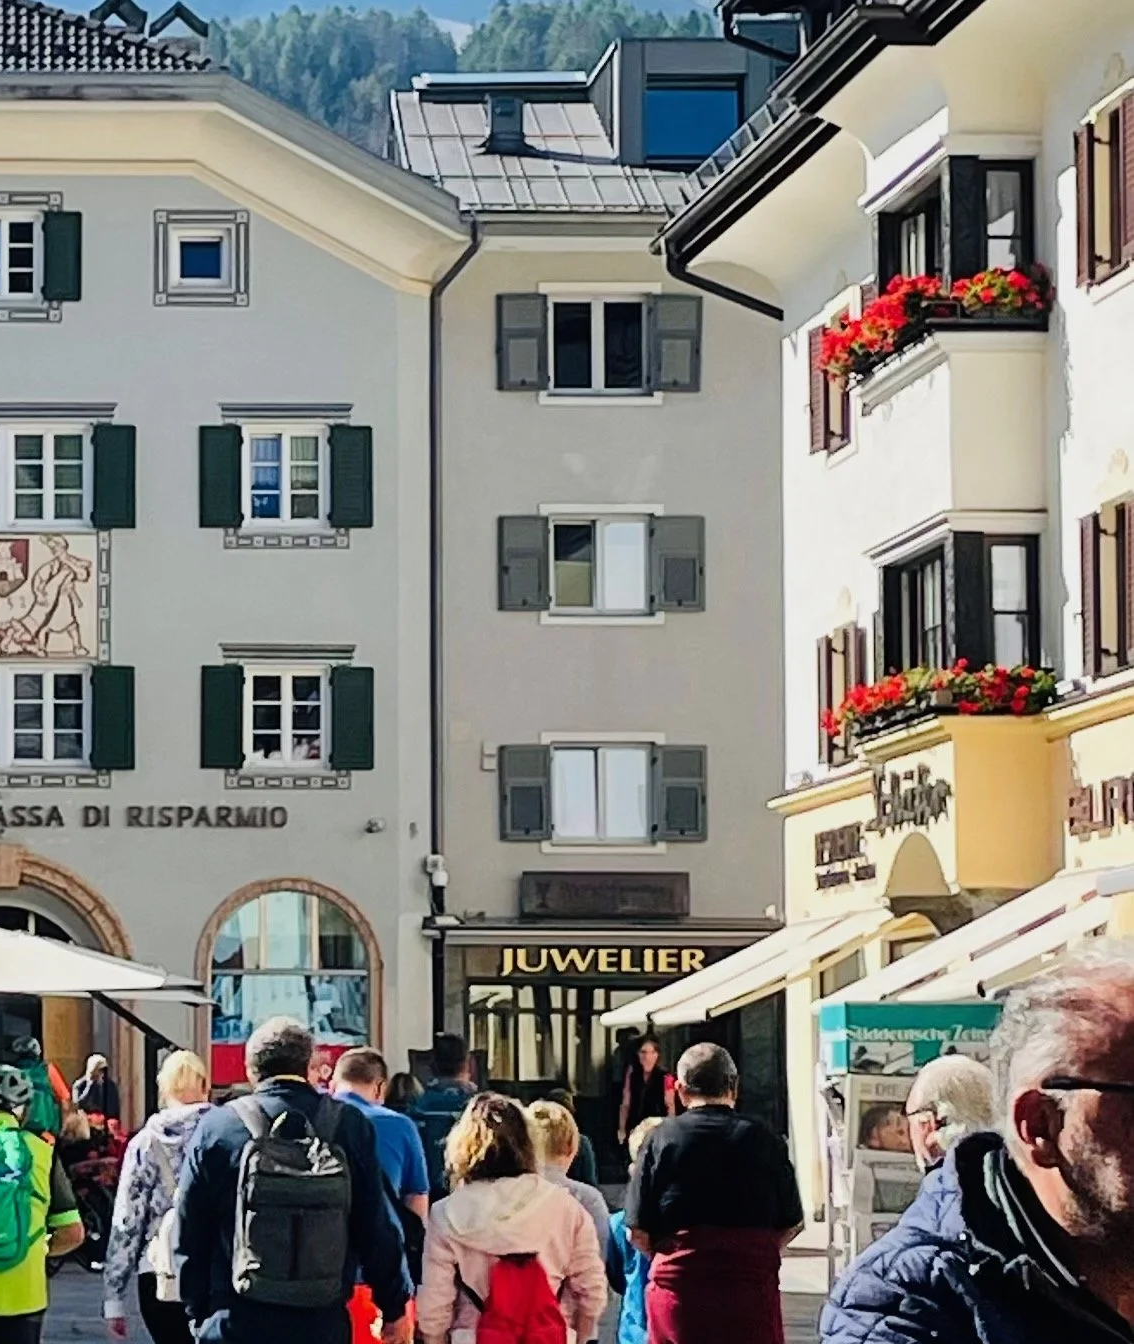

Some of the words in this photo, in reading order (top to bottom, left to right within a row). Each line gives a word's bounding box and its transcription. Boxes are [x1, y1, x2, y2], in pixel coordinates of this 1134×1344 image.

[82, 805, 111, 827] DI
[126, 805, 289, 828] RISPARMIO
[500, 947, 706, 977] JUWELIER
